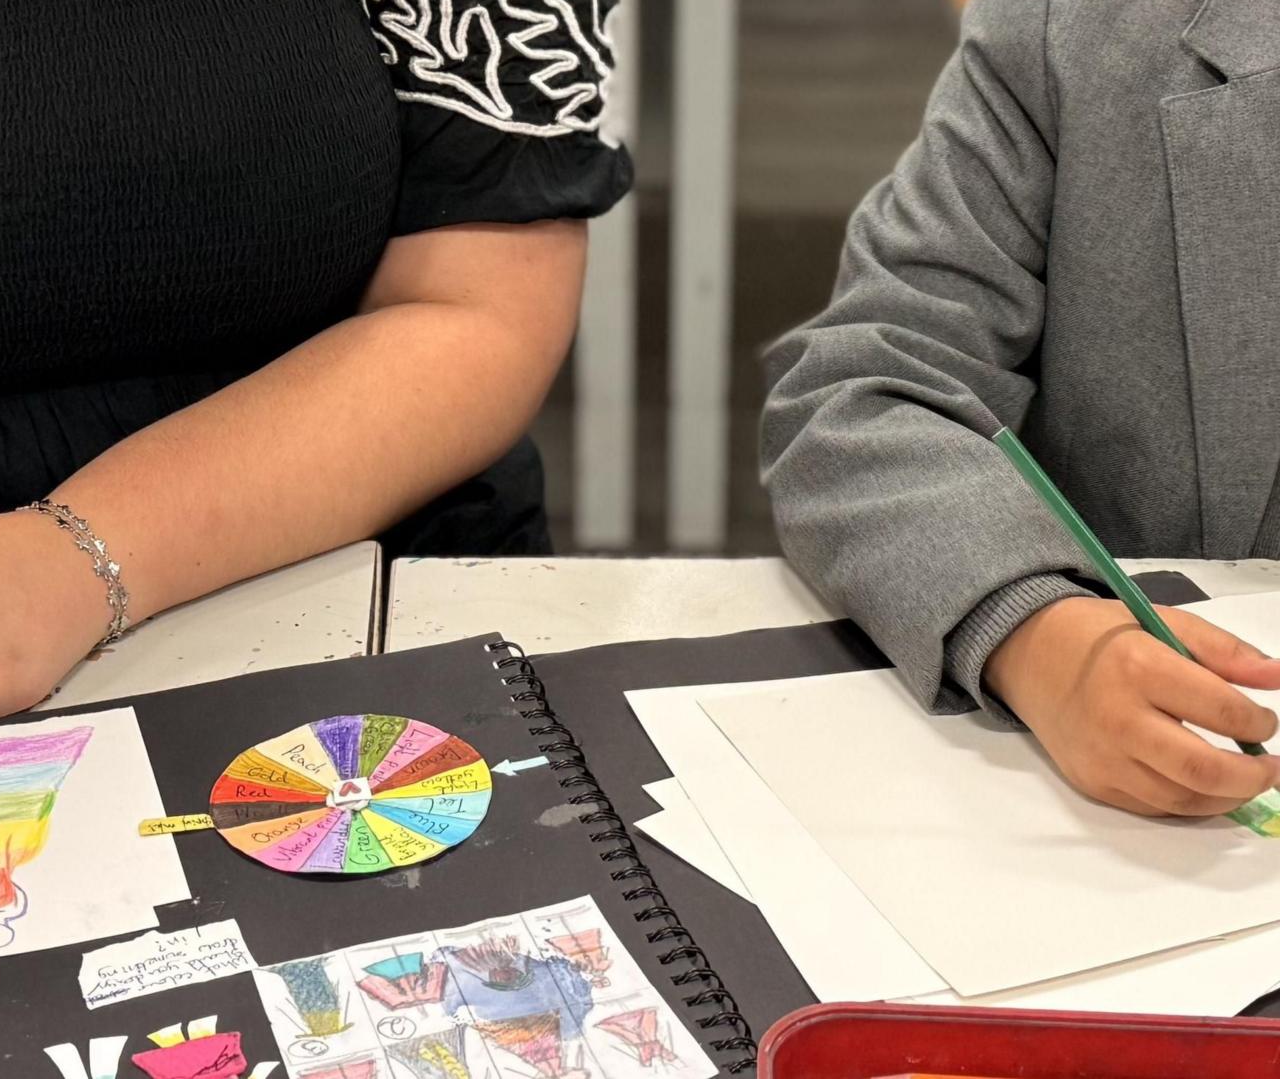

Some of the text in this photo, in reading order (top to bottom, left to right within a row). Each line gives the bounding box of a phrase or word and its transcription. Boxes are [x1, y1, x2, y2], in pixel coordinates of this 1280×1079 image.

[281, 743, 327, 775] Peach
[248, 767, 290, 785] Gold
[235, 784, 273, 799] Red
[250, 816, 309, 845] Orange
[408, 812, 450, 836] Blue
[349, 824, 381, 867] Green
